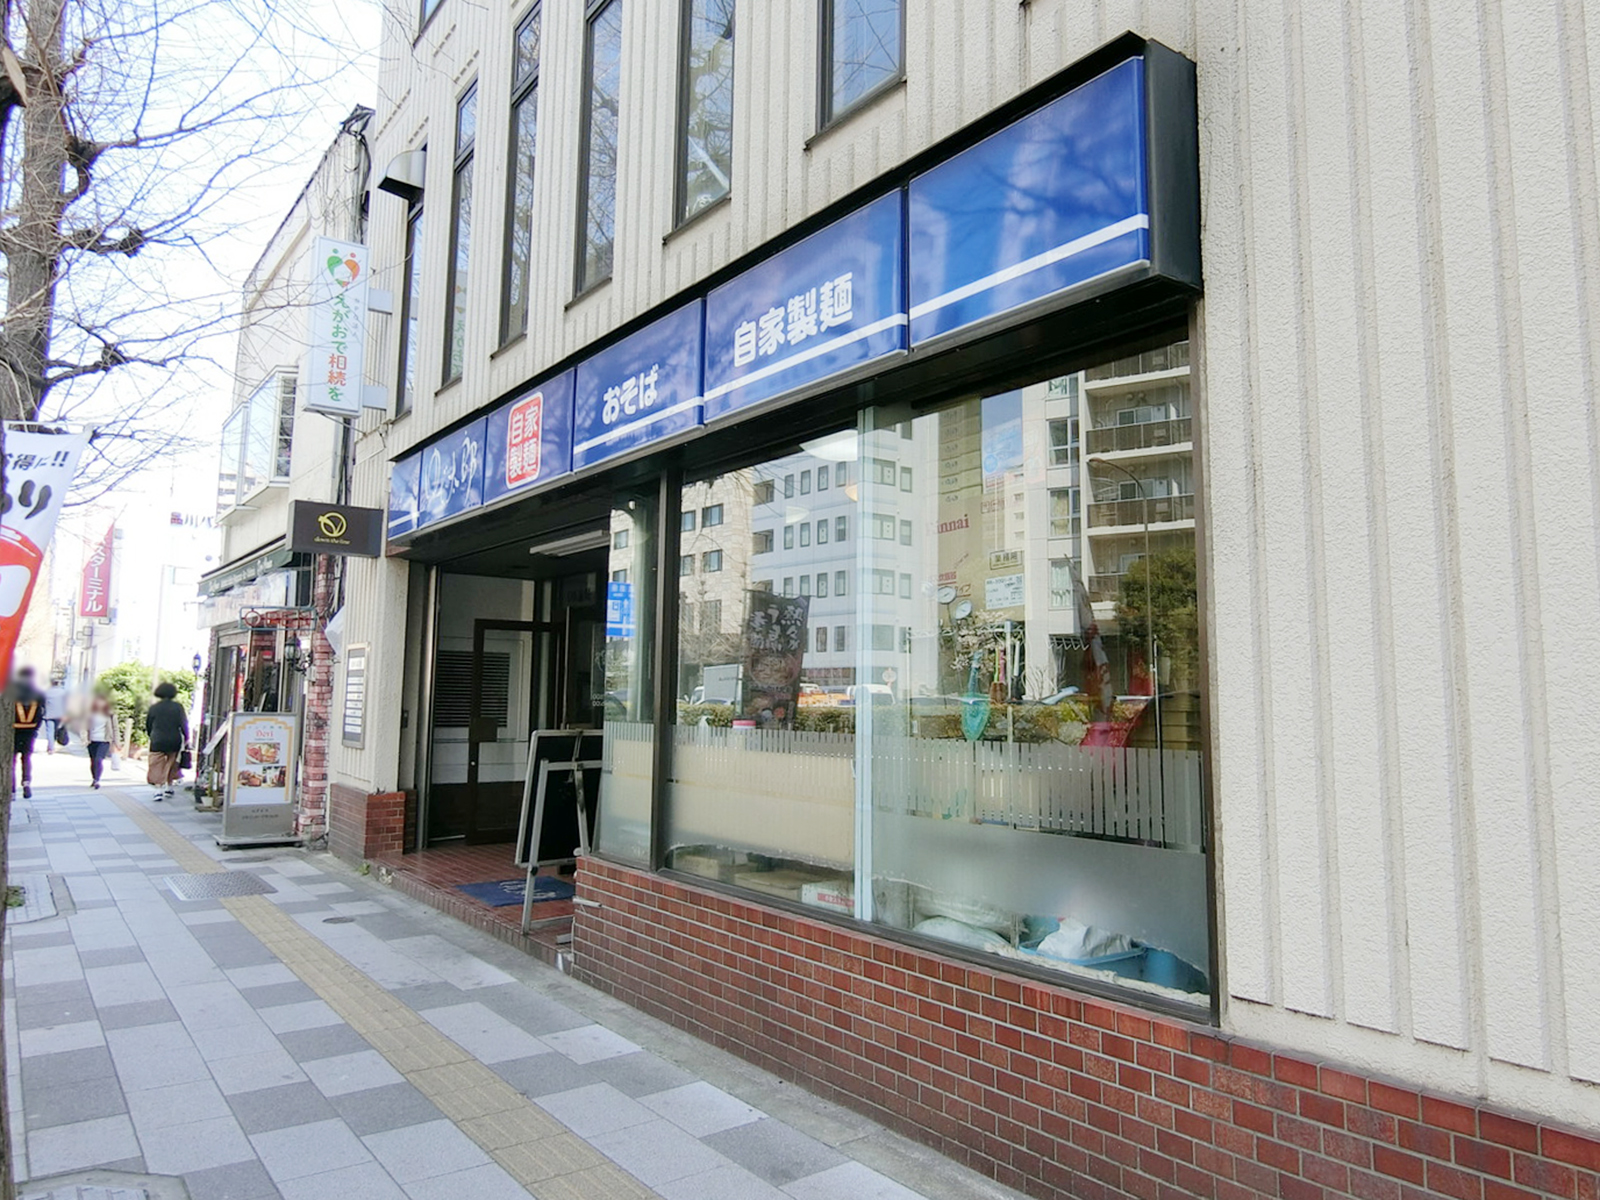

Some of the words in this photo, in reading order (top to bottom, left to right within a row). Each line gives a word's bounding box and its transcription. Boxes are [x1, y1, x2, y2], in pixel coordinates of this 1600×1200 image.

[327, 292, 350, 402] えがおで相続を
[733, 272, 853, 368] 自家製麺
[602, 363, 659, 425] おそば
[6, 451, 70, 471] 得に!!
